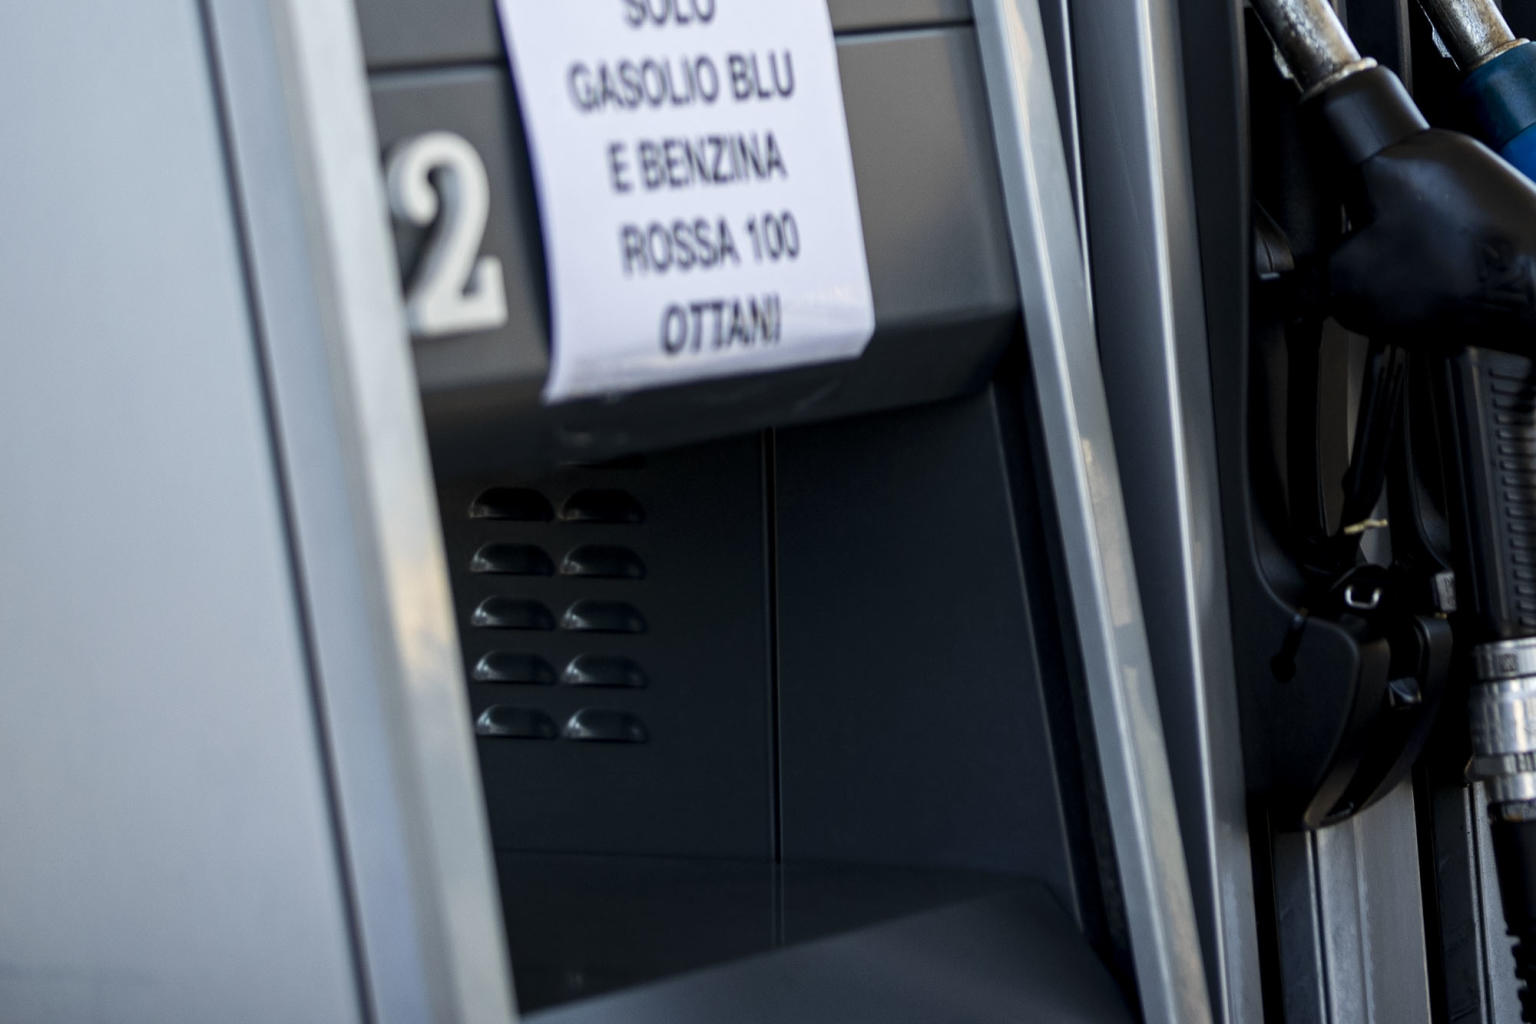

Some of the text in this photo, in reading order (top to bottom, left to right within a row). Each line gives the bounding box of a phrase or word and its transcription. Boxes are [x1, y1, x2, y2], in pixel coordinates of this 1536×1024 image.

[567, 48, 796, 114] GASOLIO BLU
[606, 130, 789, 195] E BENZINA
[388, 129, 509, 337] 2
[619, 210, 801, 276] ROSSA 100
[660, 293, 782, 356] OTTANI
